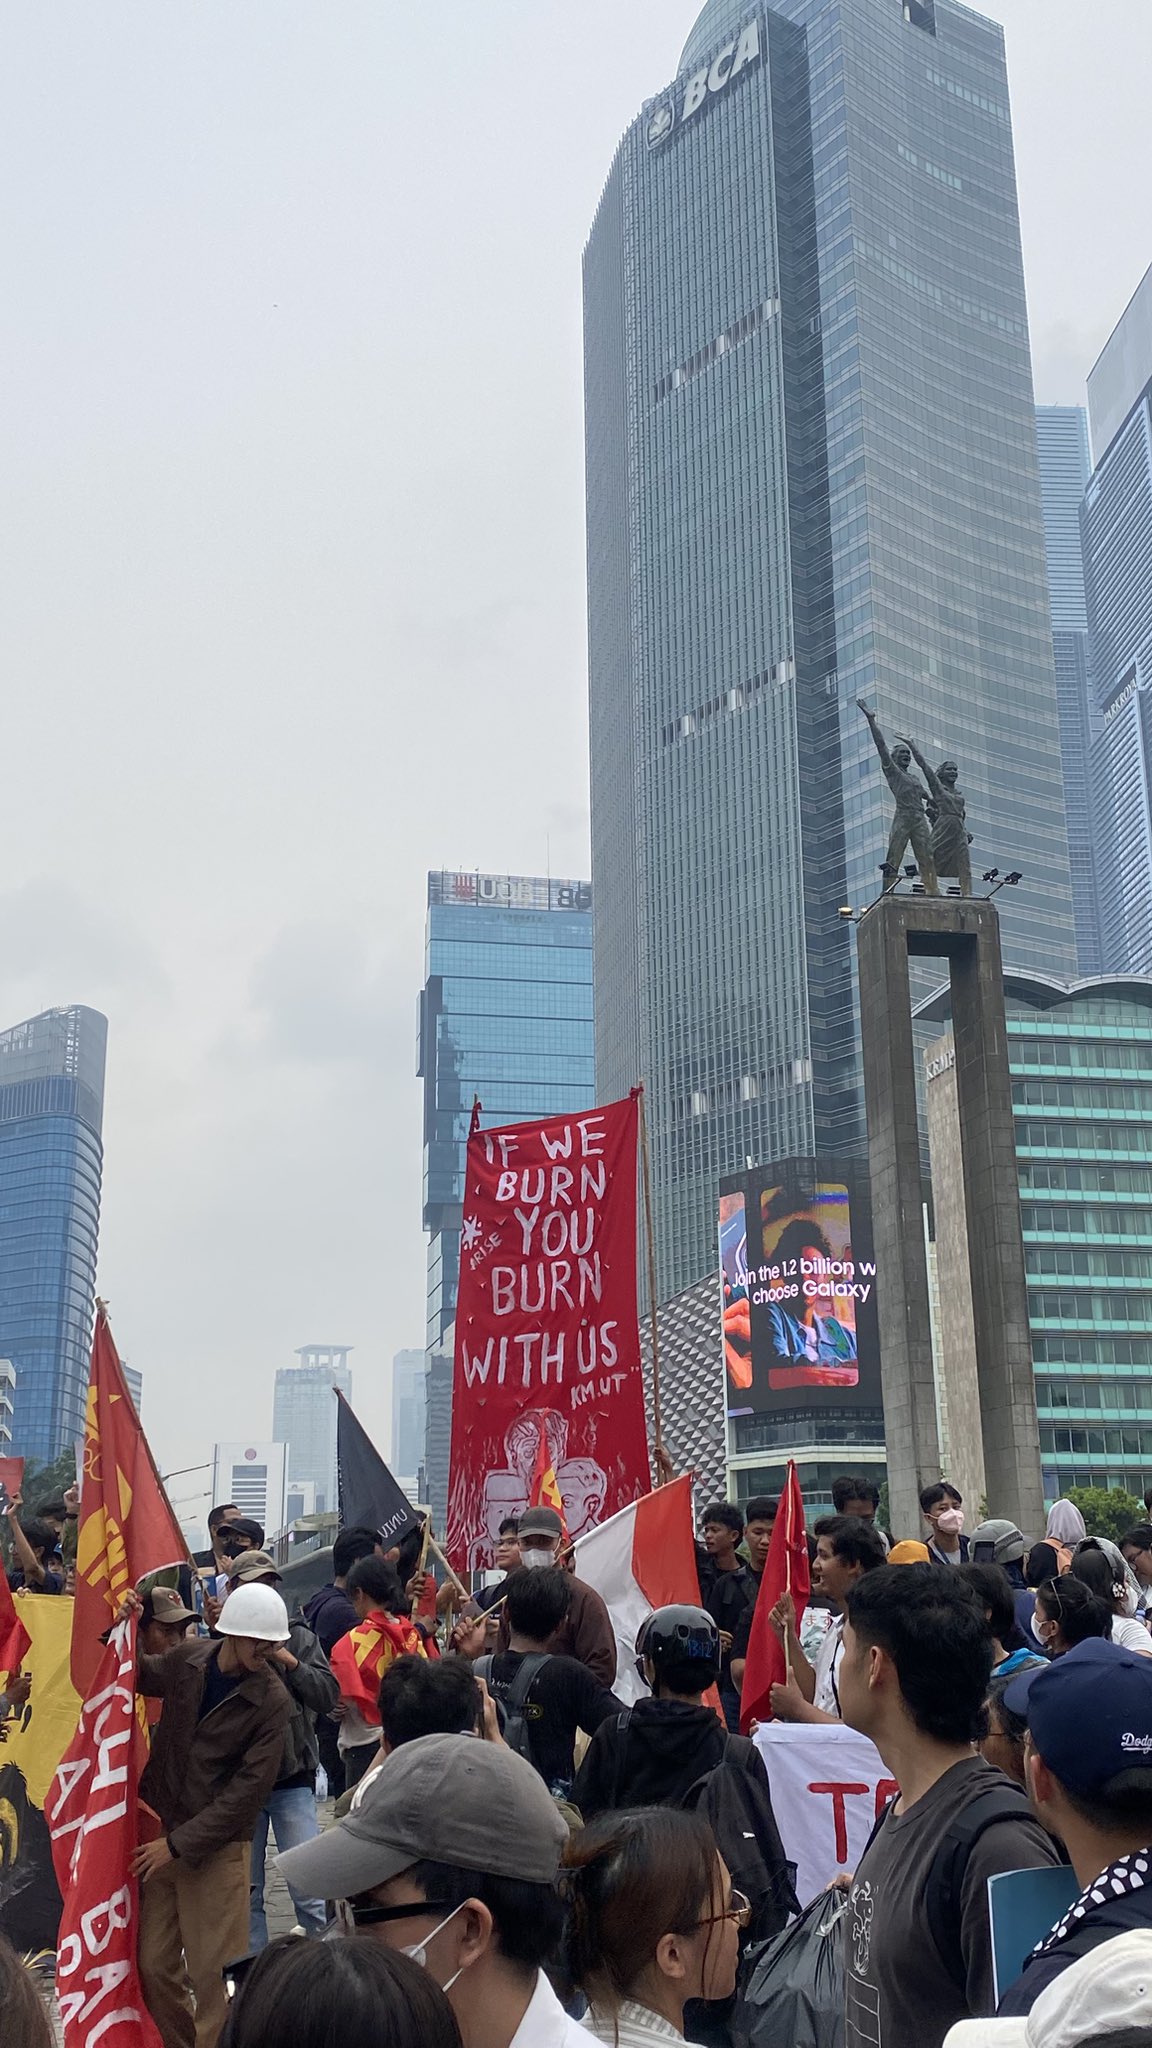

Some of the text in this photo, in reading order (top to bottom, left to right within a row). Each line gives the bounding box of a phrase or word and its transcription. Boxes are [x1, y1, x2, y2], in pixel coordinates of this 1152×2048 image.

[682, 19, 759, 122] BCA
[480, 879, 533, 901] UOB
[484, 1116, 606, 1168] IF WE
[496, 1160, 606, 1206] BURN
[469, 1231, 503, 1270] ARISE
[513, 1206, 594, 1257] YOU
[491, 1251, 602, 1316] BURN
[732, 1268, 756, 1288] Join
[758, 1265, 780, 1281] the
[782, 1259, 797, 1277] 1.2
[800, 1257, 855, 1275] billion
[753, 1279, 871, 1305] choose Galaxy
[462, 1321, 618, 1388] WITH US
